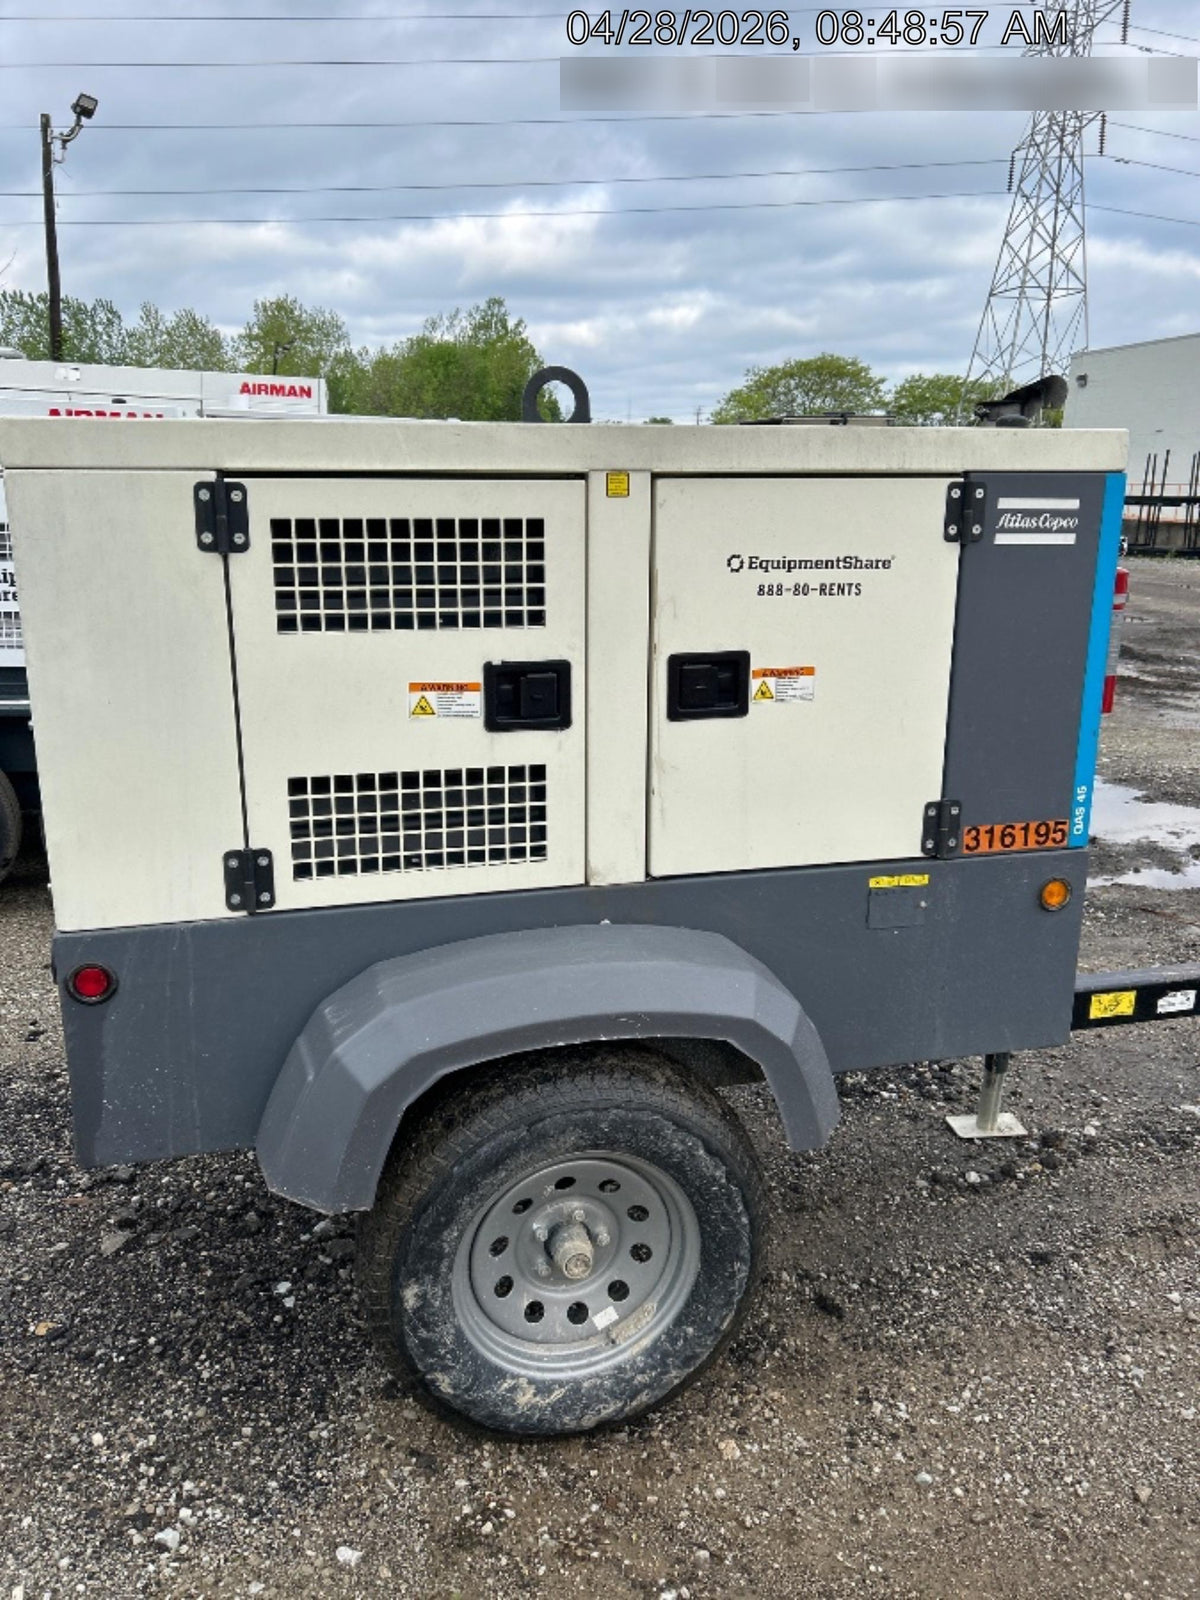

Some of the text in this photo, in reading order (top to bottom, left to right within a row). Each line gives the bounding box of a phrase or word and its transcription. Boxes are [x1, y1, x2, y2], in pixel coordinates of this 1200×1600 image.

[239, 381, 312, 399] AIRMAN
[995, 513, 1079, 532] Atlas Copco
[747, 555, 893, 574] EquipmentShare
[757, 582, 863, 597] 888-80-RENTS
[1073, 806, 1086, 836] QAS
[964, 820, 1068, 852] 316195
